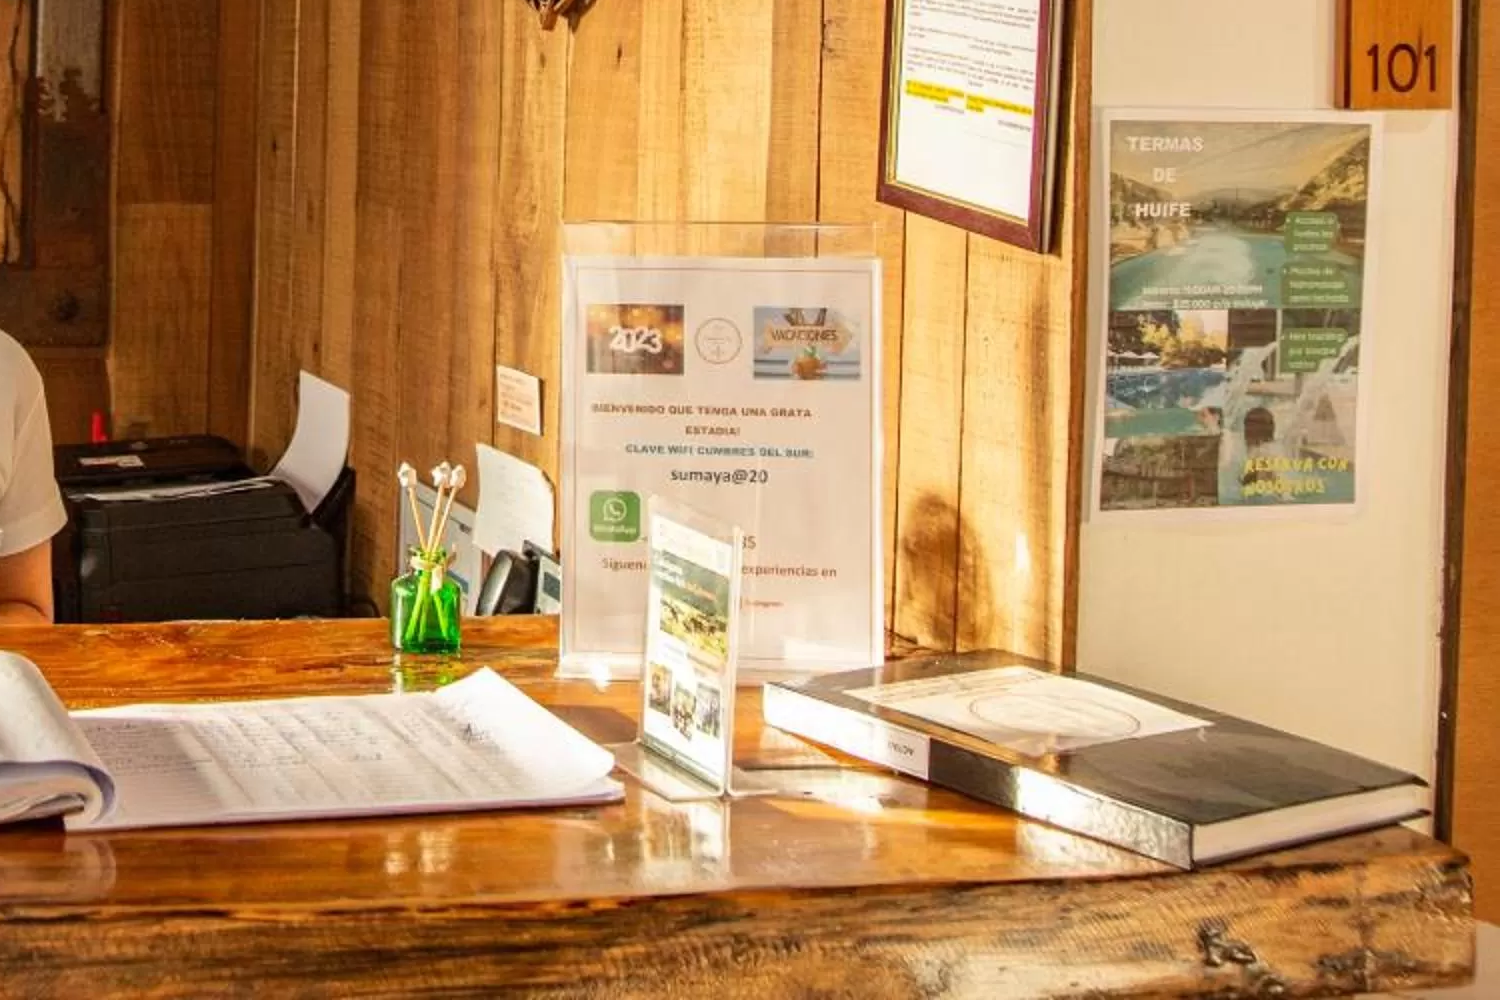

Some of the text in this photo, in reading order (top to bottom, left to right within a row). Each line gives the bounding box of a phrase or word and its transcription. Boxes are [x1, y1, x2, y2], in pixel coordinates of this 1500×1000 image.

[1366, 42, 1439, 93] 101
[1126, 136, 1205, 153] TERMAS
[1152, 167, 1177, 184] DE
[1135, 202, 1192, 218] HUIFE
[608, 325, 664, 354] 2023
[591, 403, 813, 418] BIENVENIDO QUE TENGA UNA GRATA
[625, 444, 666, 455] CLAVE
[696, 446, 756, 457] CUMBRES
[759, 447, 783, 458] DEL
[670, 469, 769, 485] sumaya@20
[741, 564, 819, 579] experiencias
[820, 567, 838, 579] en
